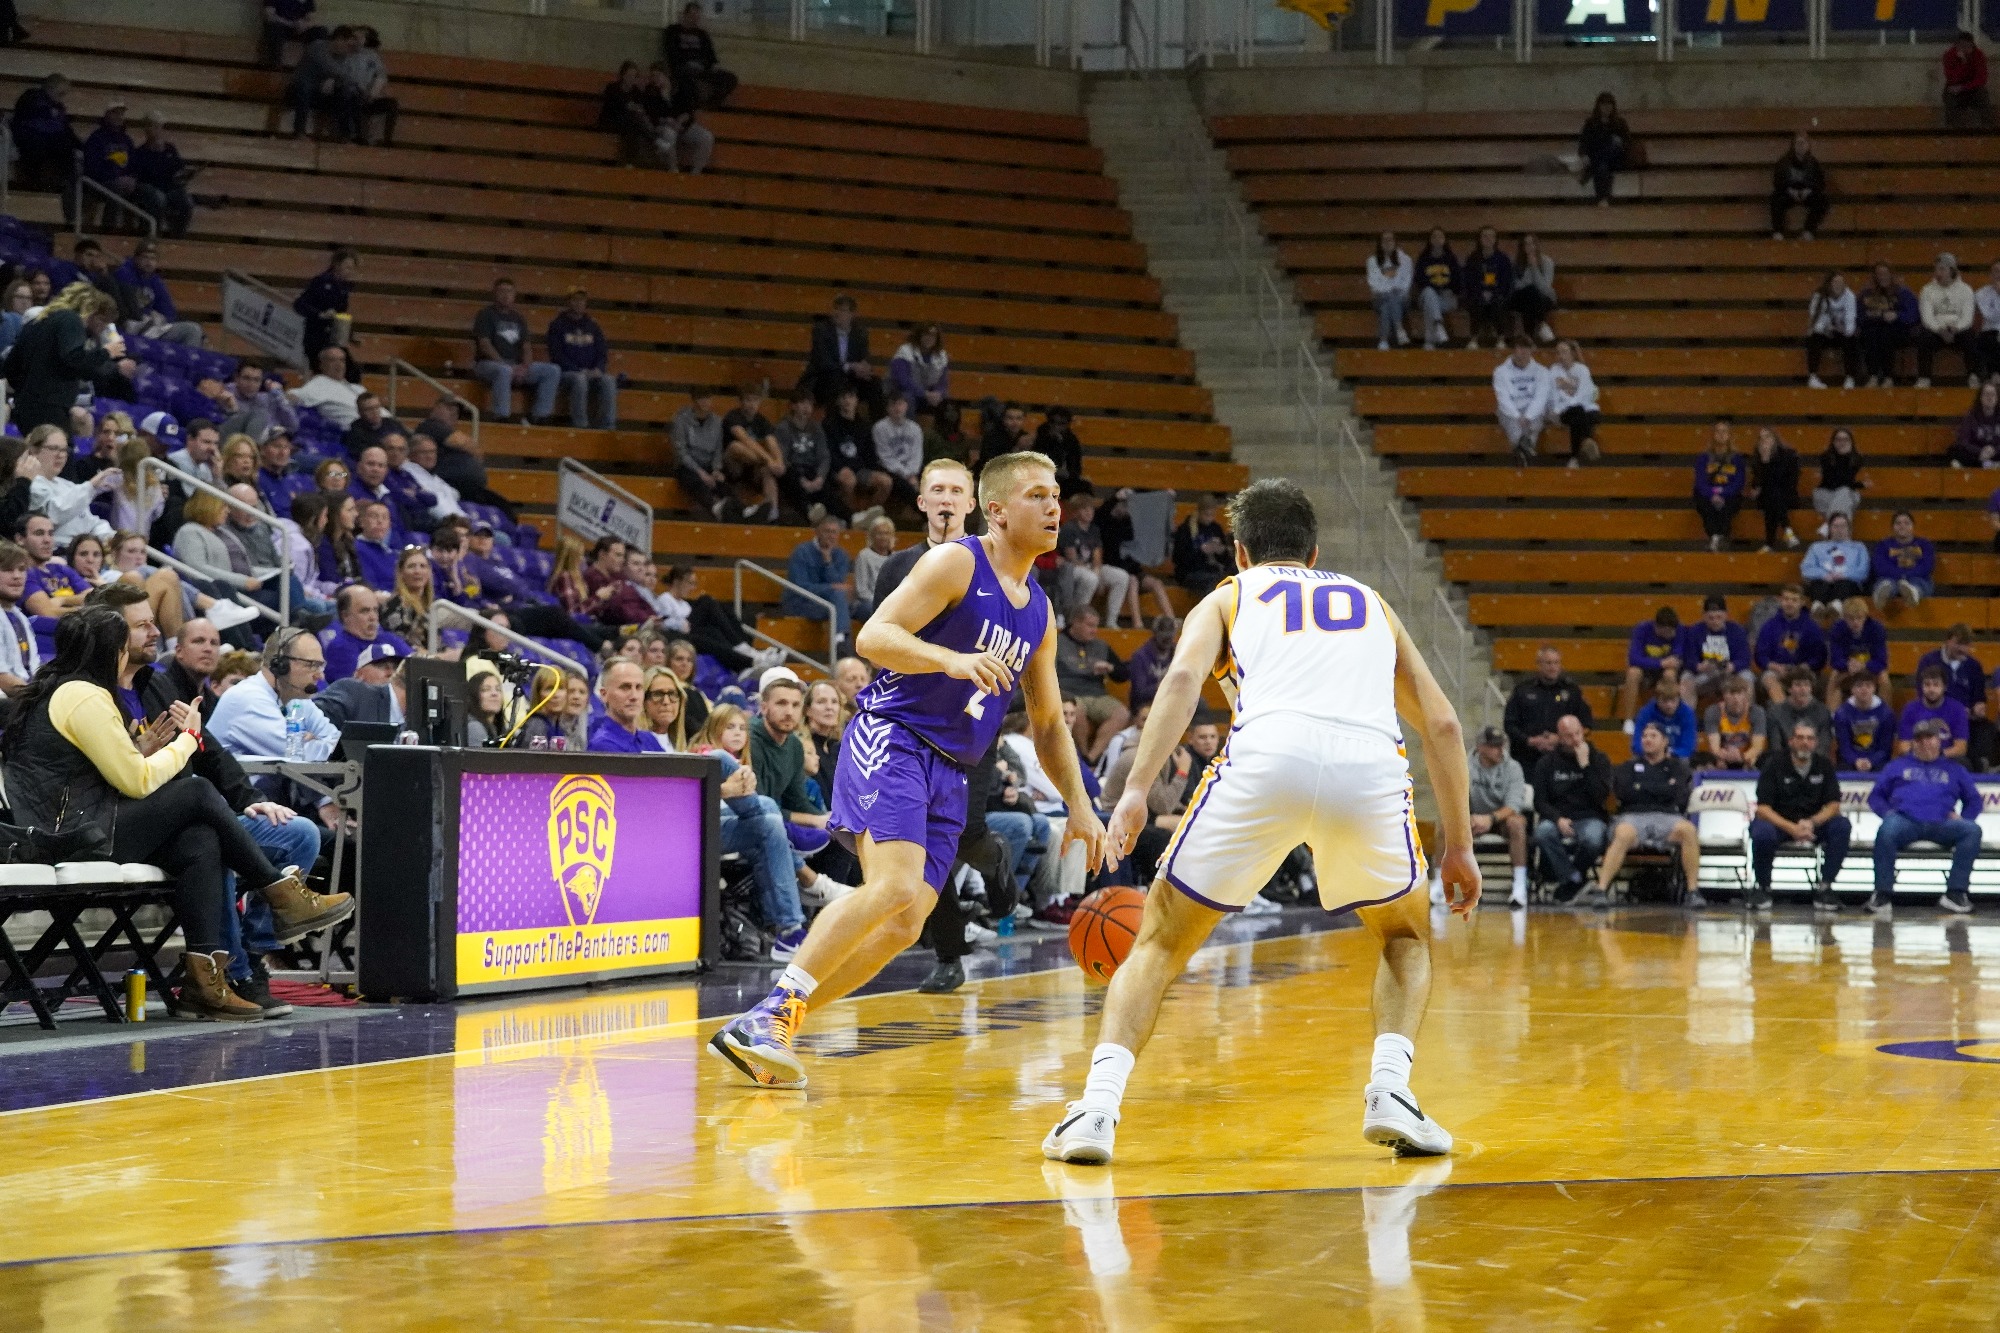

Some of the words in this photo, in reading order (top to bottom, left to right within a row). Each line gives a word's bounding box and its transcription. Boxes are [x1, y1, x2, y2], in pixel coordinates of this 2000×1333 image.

[1256, 579, 1369, 635] 10
[974, 618, 1031, 672] LORAS
[964, 688, 988, 721] 2
[1700, 790, 1734, 802] UNI
[556, 800, 609, 866] PSC
[484, 929, 670, 975] SupportThePanthers.com
